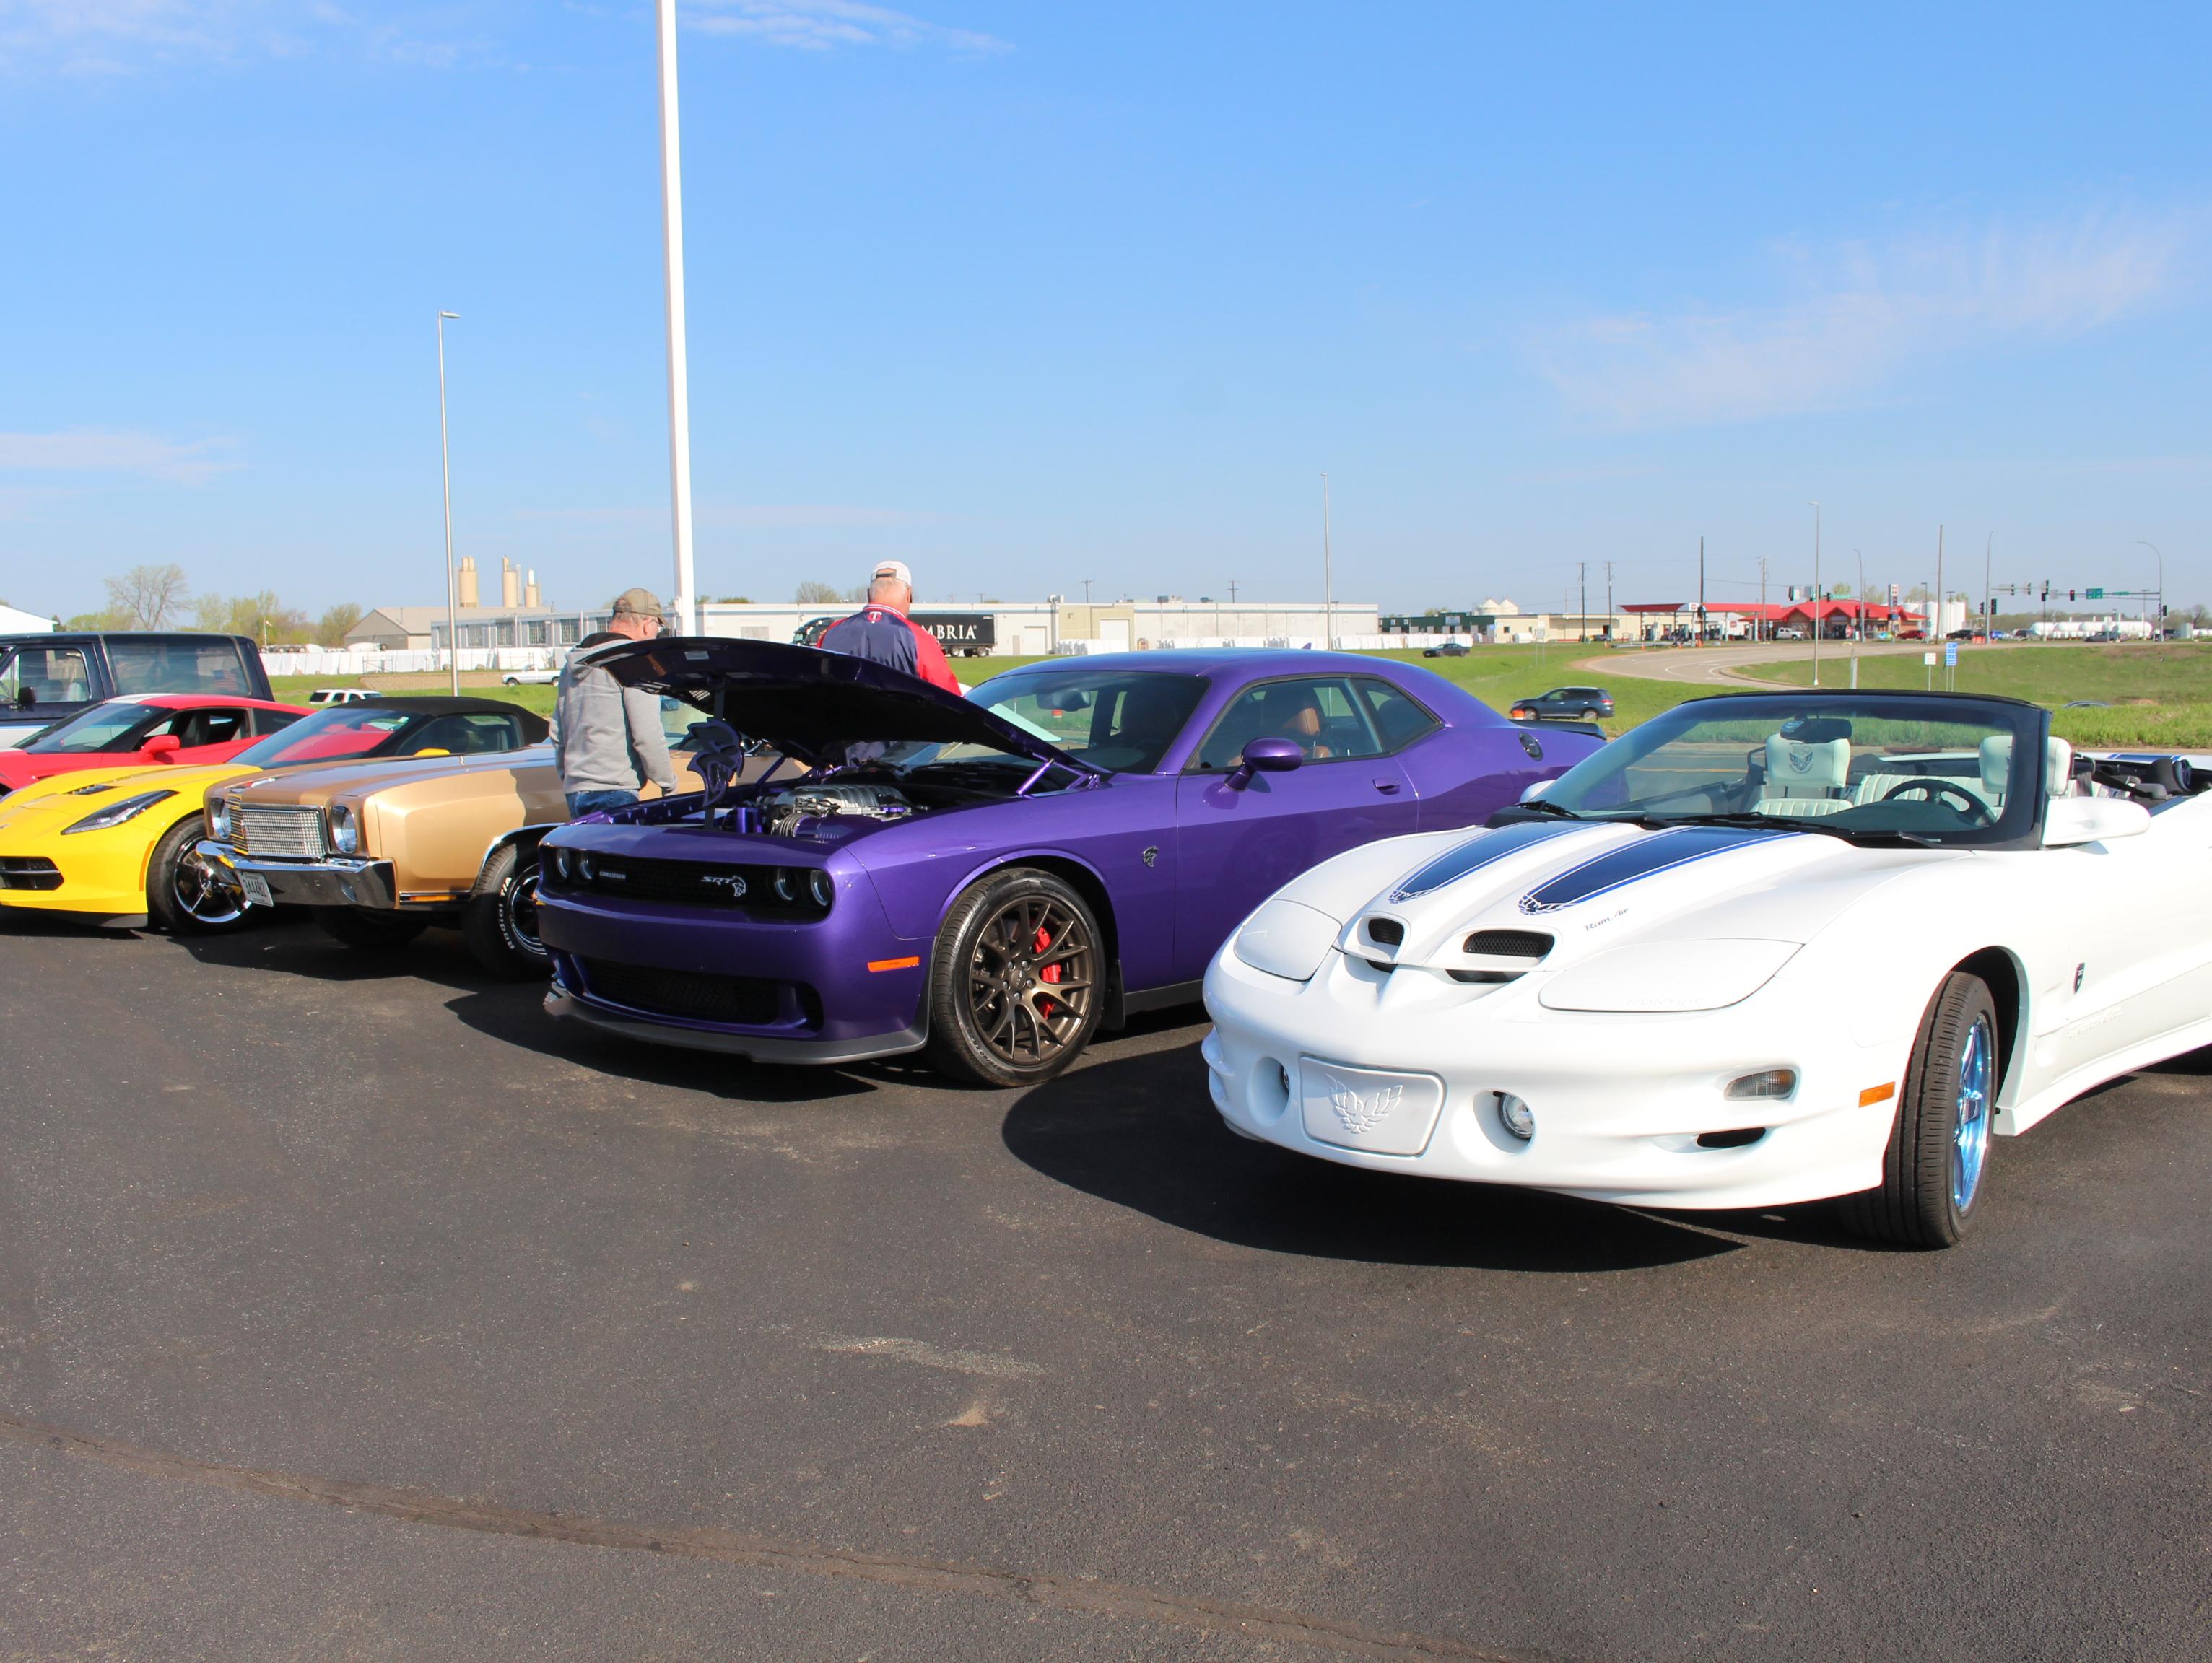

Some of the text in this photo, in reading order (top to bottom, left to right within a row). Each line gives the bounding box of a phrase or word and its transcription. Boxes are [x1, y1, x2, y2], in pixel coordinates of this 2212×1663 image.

[921, 624, 976, 640] MBRIA
[700, 876, 734, 886] SRT
[1584, 908, 1629, 931] Ram Air
